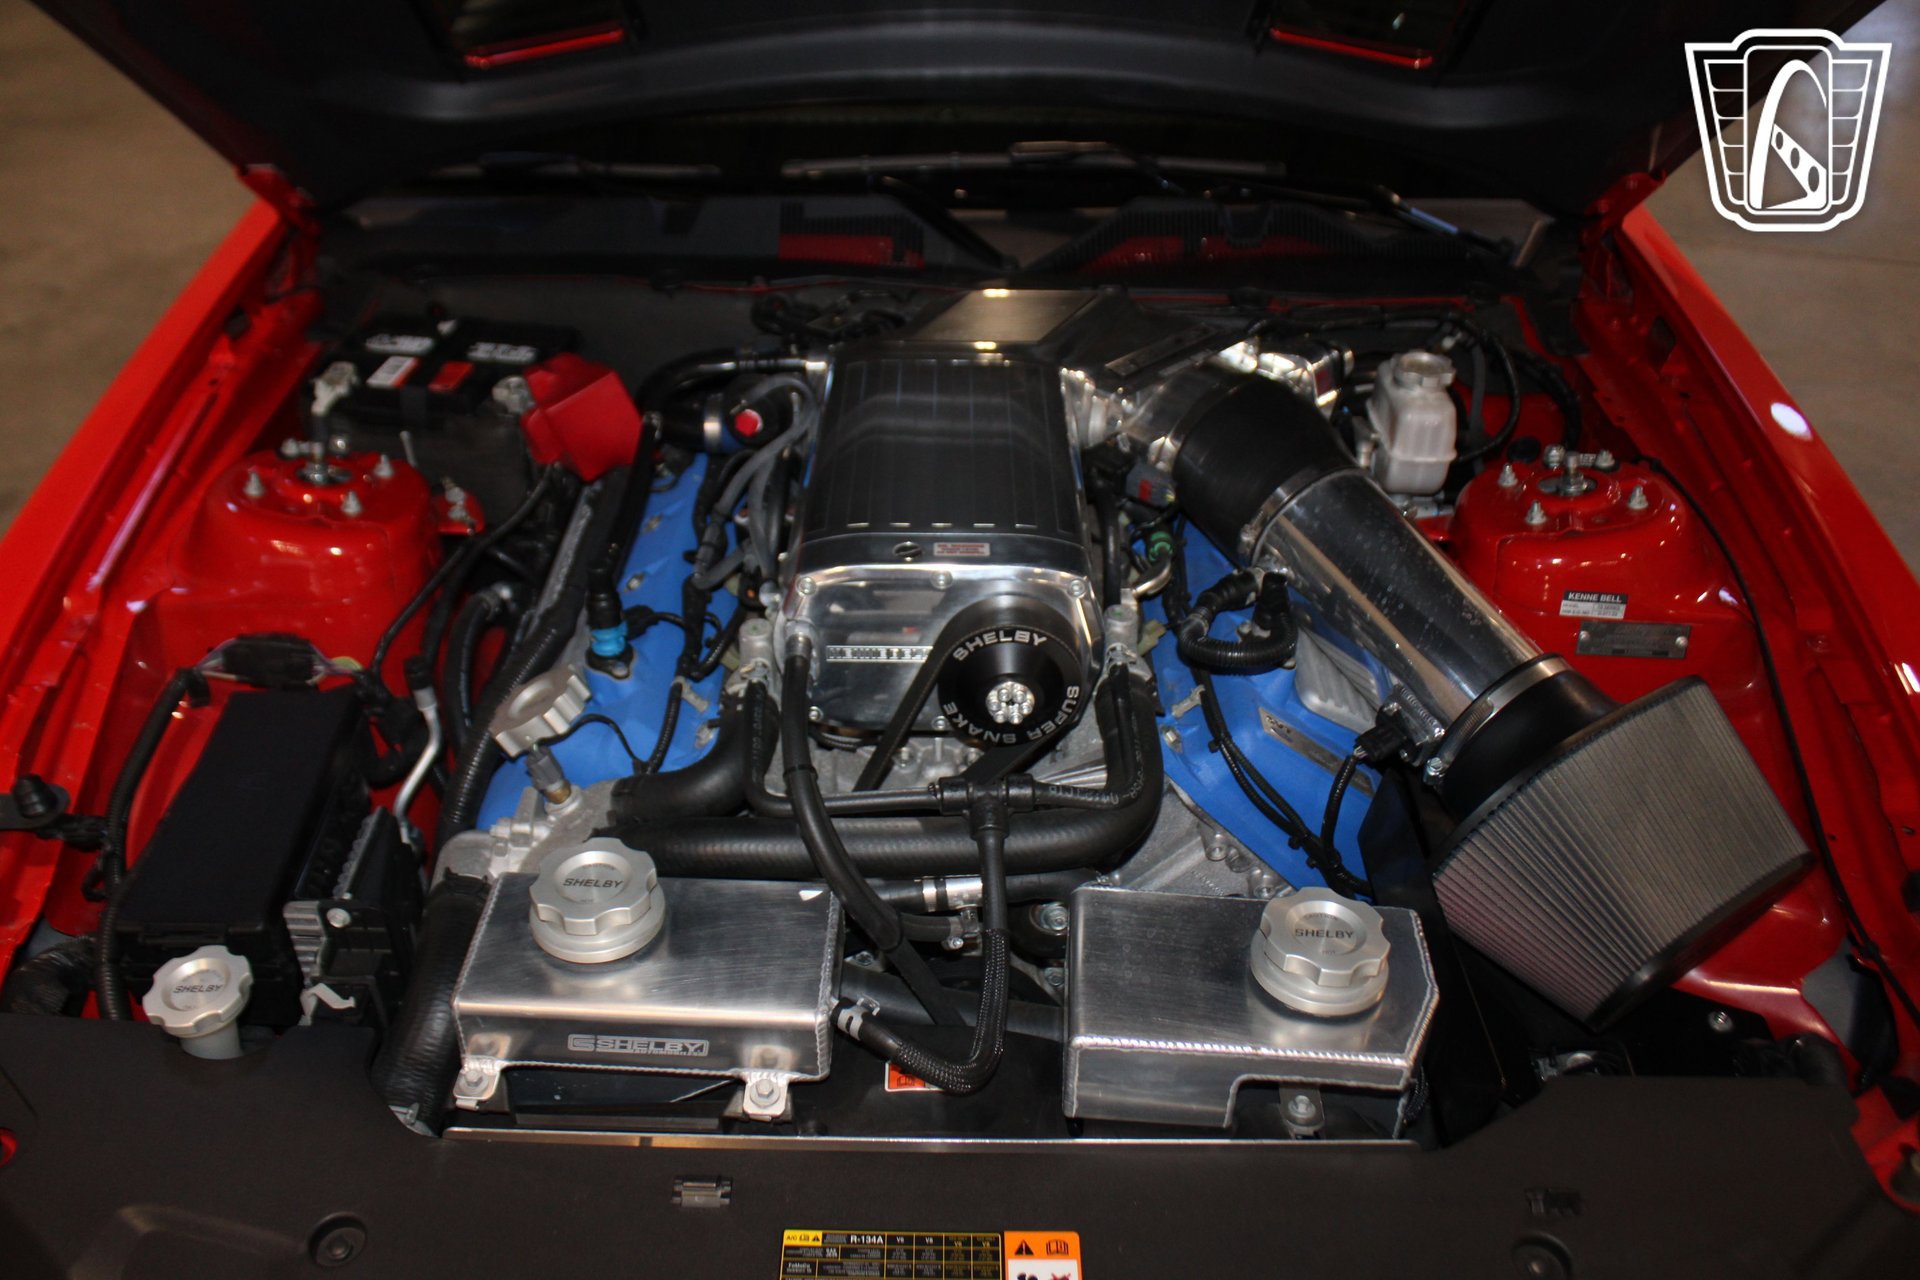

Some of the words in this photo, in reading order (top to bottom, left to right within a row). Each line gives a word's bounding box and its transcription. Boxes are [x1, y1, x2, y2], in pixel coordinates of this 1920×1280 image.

[1568, 592, 1599, 601] KENNE
[1600, 594, 1622, 603] BELL
[953, 630, 1047, 660] SHELBY
[1027, 685, 1080, 740] SUPER
[943, 701, 1017, 744] SNAKE
[563, 878, 624, 888] SHELBY
[1295, 928, 1354, 939] SHELBY
[174, 985, 223, 993] SHELBY
[597, 1039, 705, 1053] SHELBY
[850, 1235, 884, 1244] R-134A
